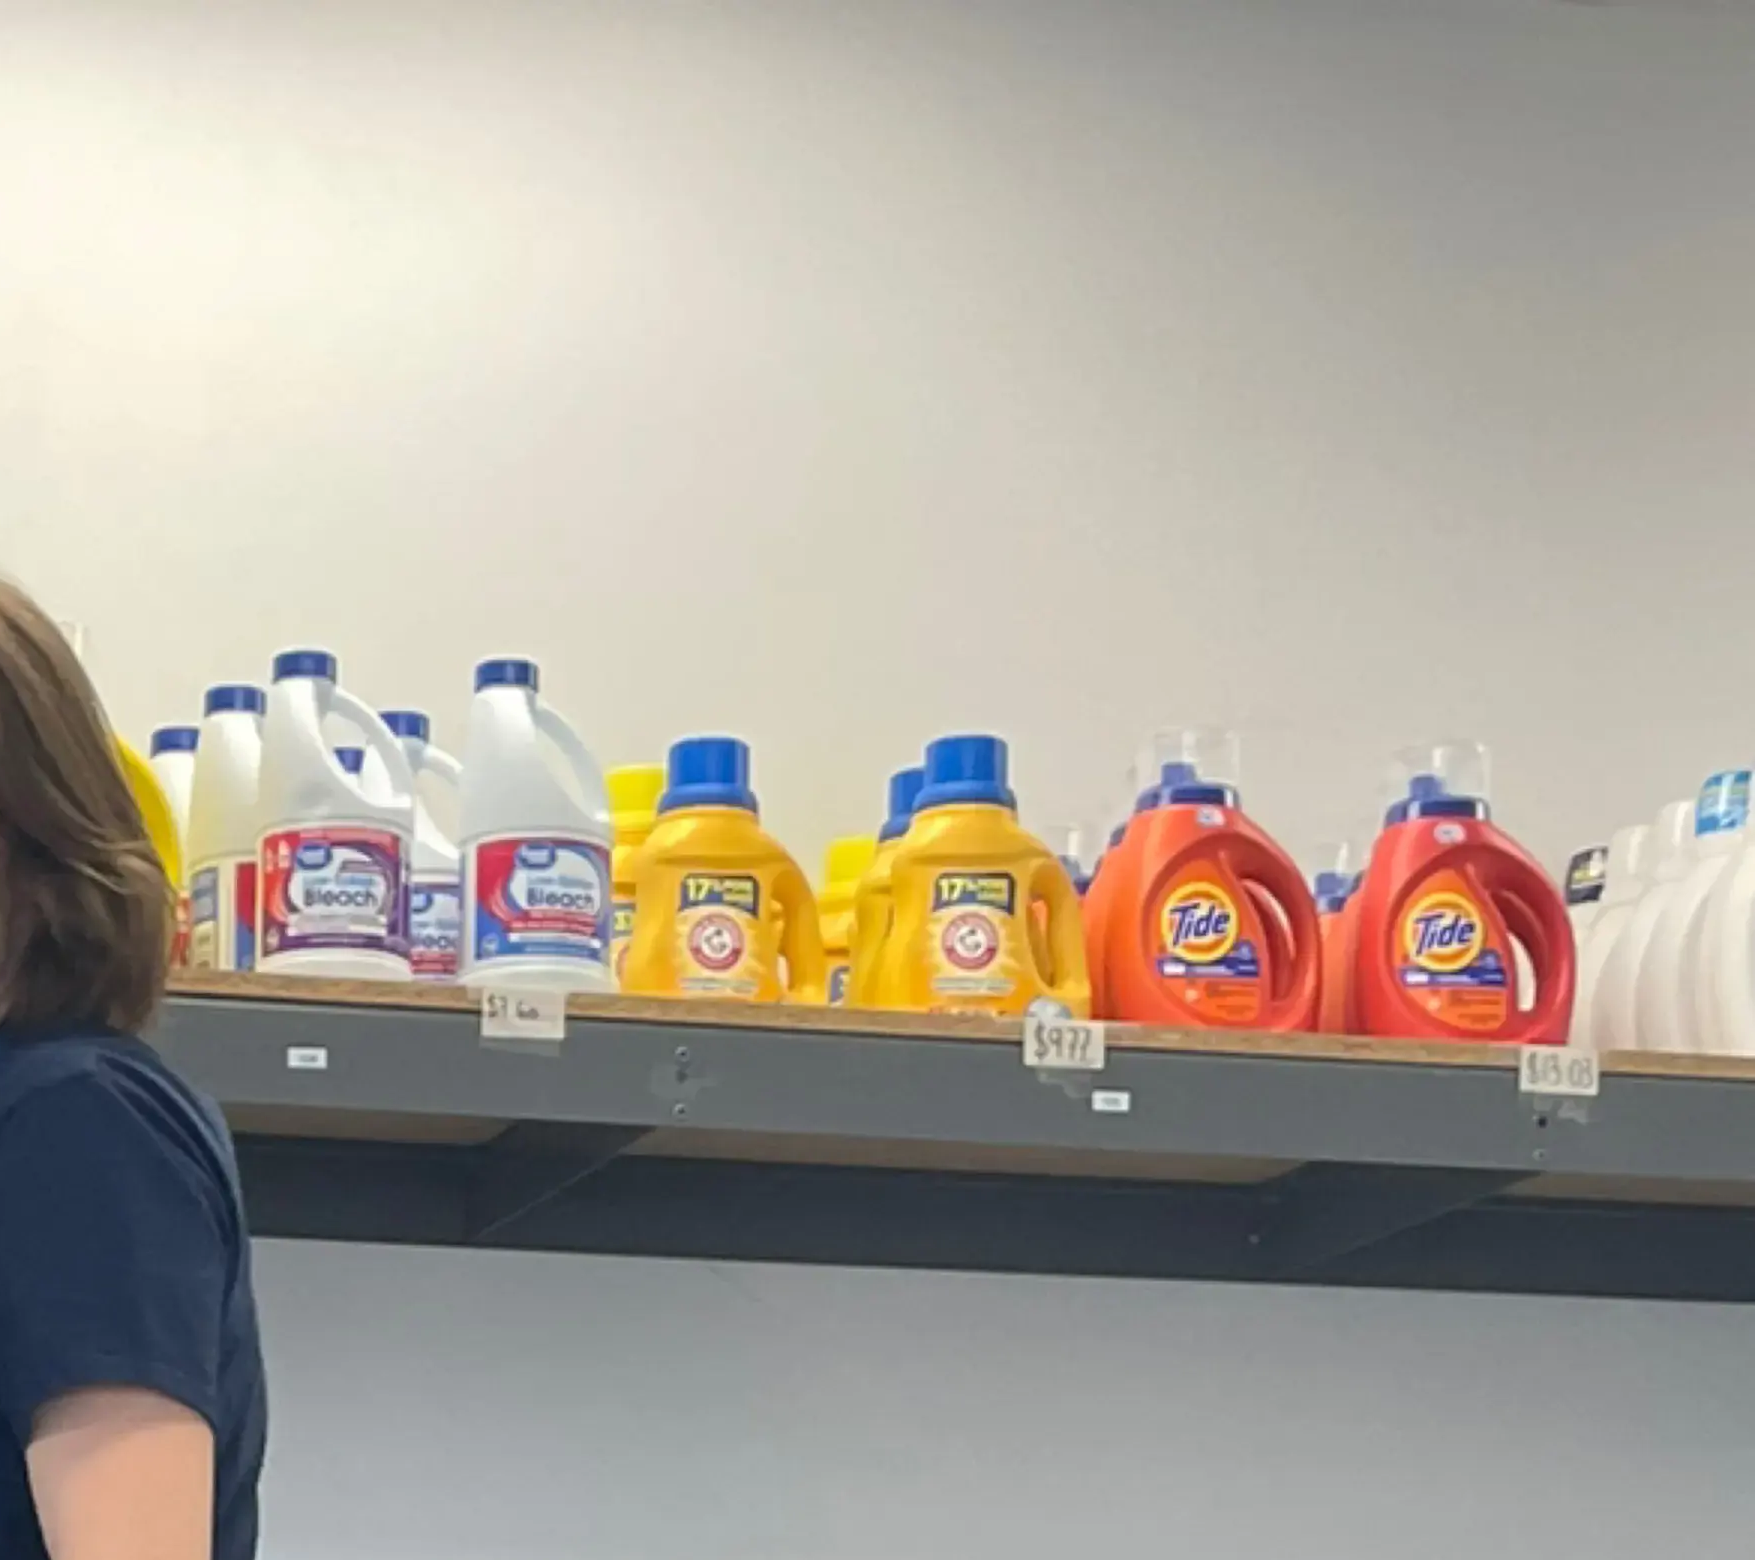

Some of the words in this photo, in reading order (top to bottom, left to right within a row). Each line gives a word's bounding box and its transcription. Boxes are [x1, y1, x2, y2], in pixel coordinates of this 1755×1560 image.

[303, 887, 379, 908] Bleach
[527, 887, 596, 910] Bleach
[1168, 901, 1231, 948] Tide
[1414, 914, 1476, 956] Tide
